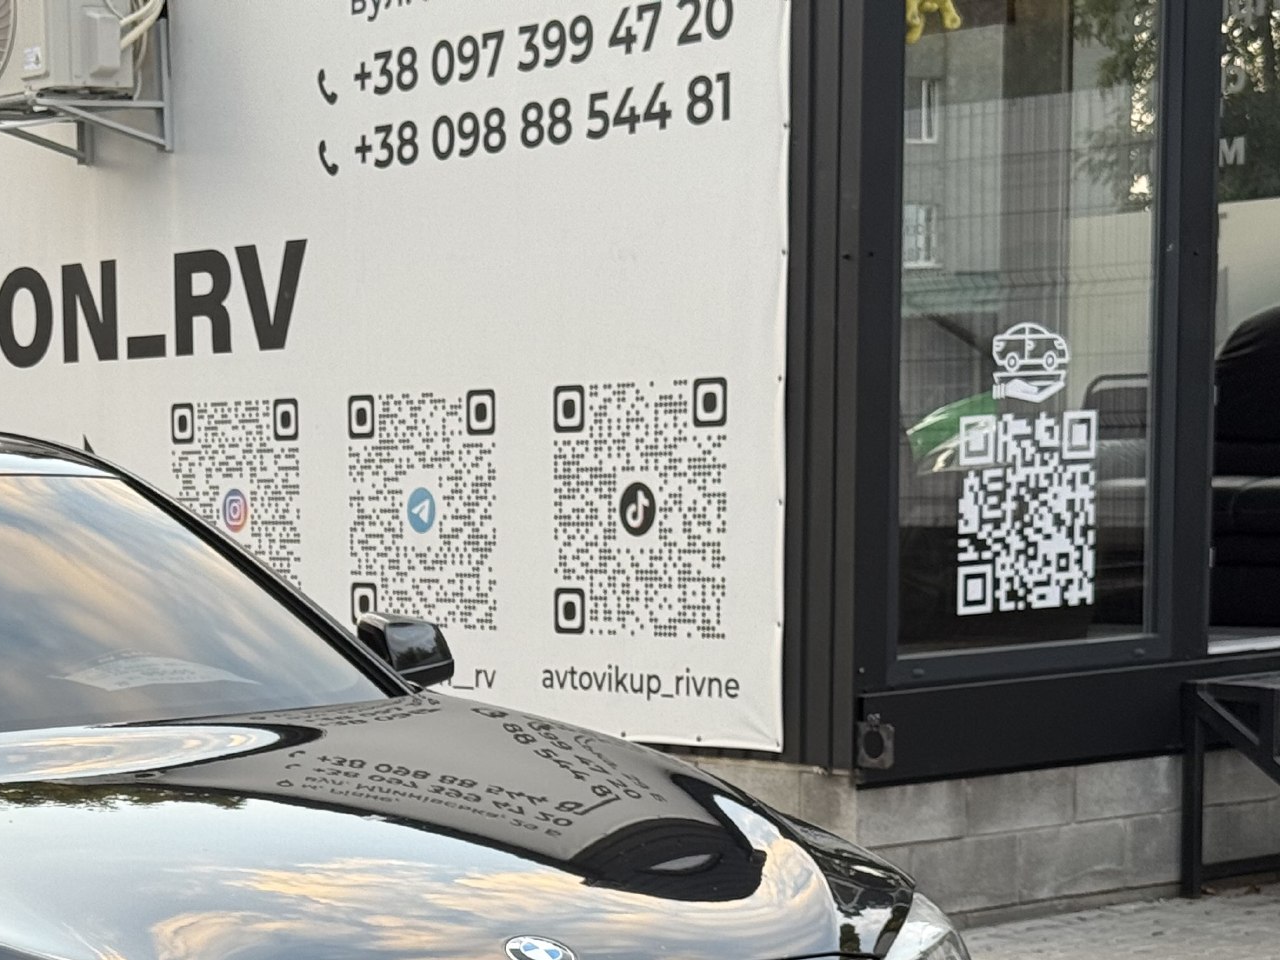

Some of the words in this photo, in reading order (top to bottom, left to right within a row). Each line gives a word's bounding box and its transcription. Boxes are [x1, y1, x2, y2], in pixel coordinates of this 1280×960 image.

[354, 46, 419, 95] +38
[431, 30, 505, 85] 097
[517, 15, 594, 72] 399
[608, 1, 662, 55] 47
[677, 0, 734, 45] 20
[354, 120, 419, 169] +38
[431, 107, 507, 161] 098
[520, 98, 573, 149] 88
[586, 82, 672, 140] 544
[686, 71, 732, 126] 81
[542, 663, 740, 701] avtovikup_rivne
